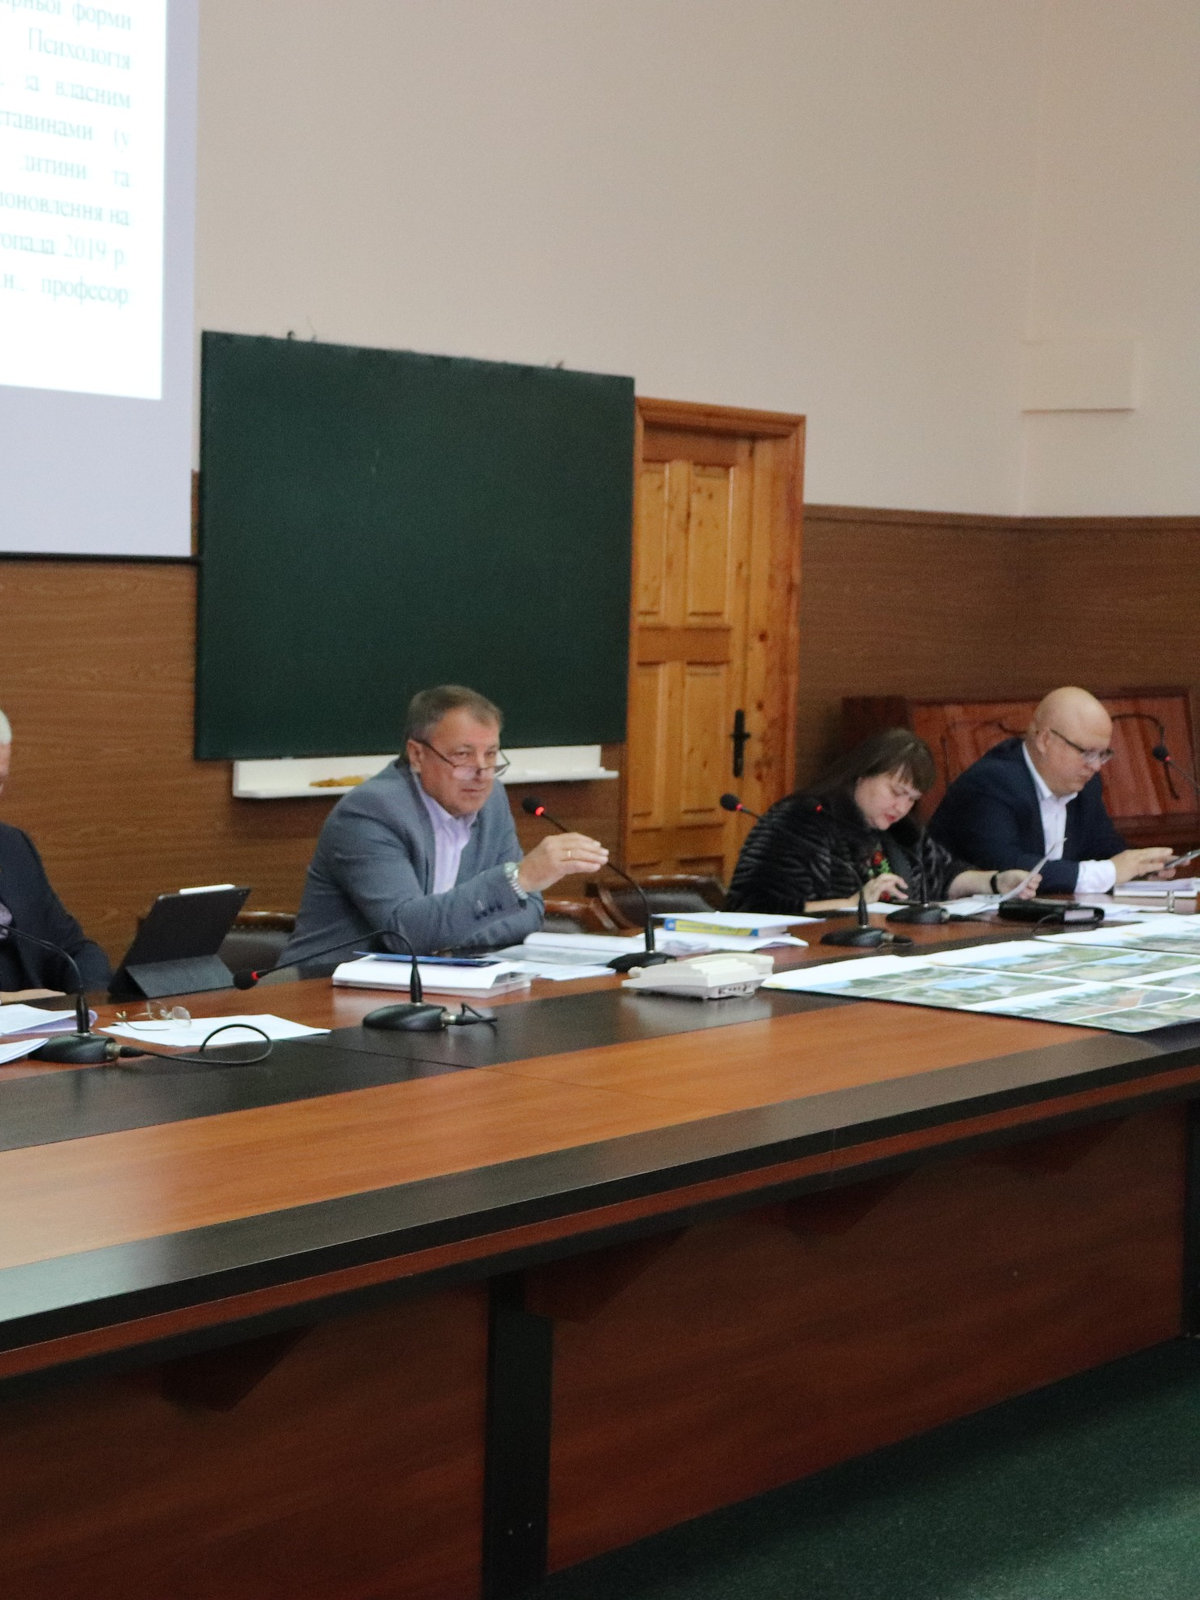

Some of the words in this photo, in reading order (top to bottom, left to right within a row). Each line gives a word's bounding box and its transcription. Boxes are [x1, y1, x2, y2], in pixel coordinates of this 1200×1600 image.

[54, 80, 131, 109] власним
[109, 207, 130, 227] на
[41, 274, 130, 311] професор
